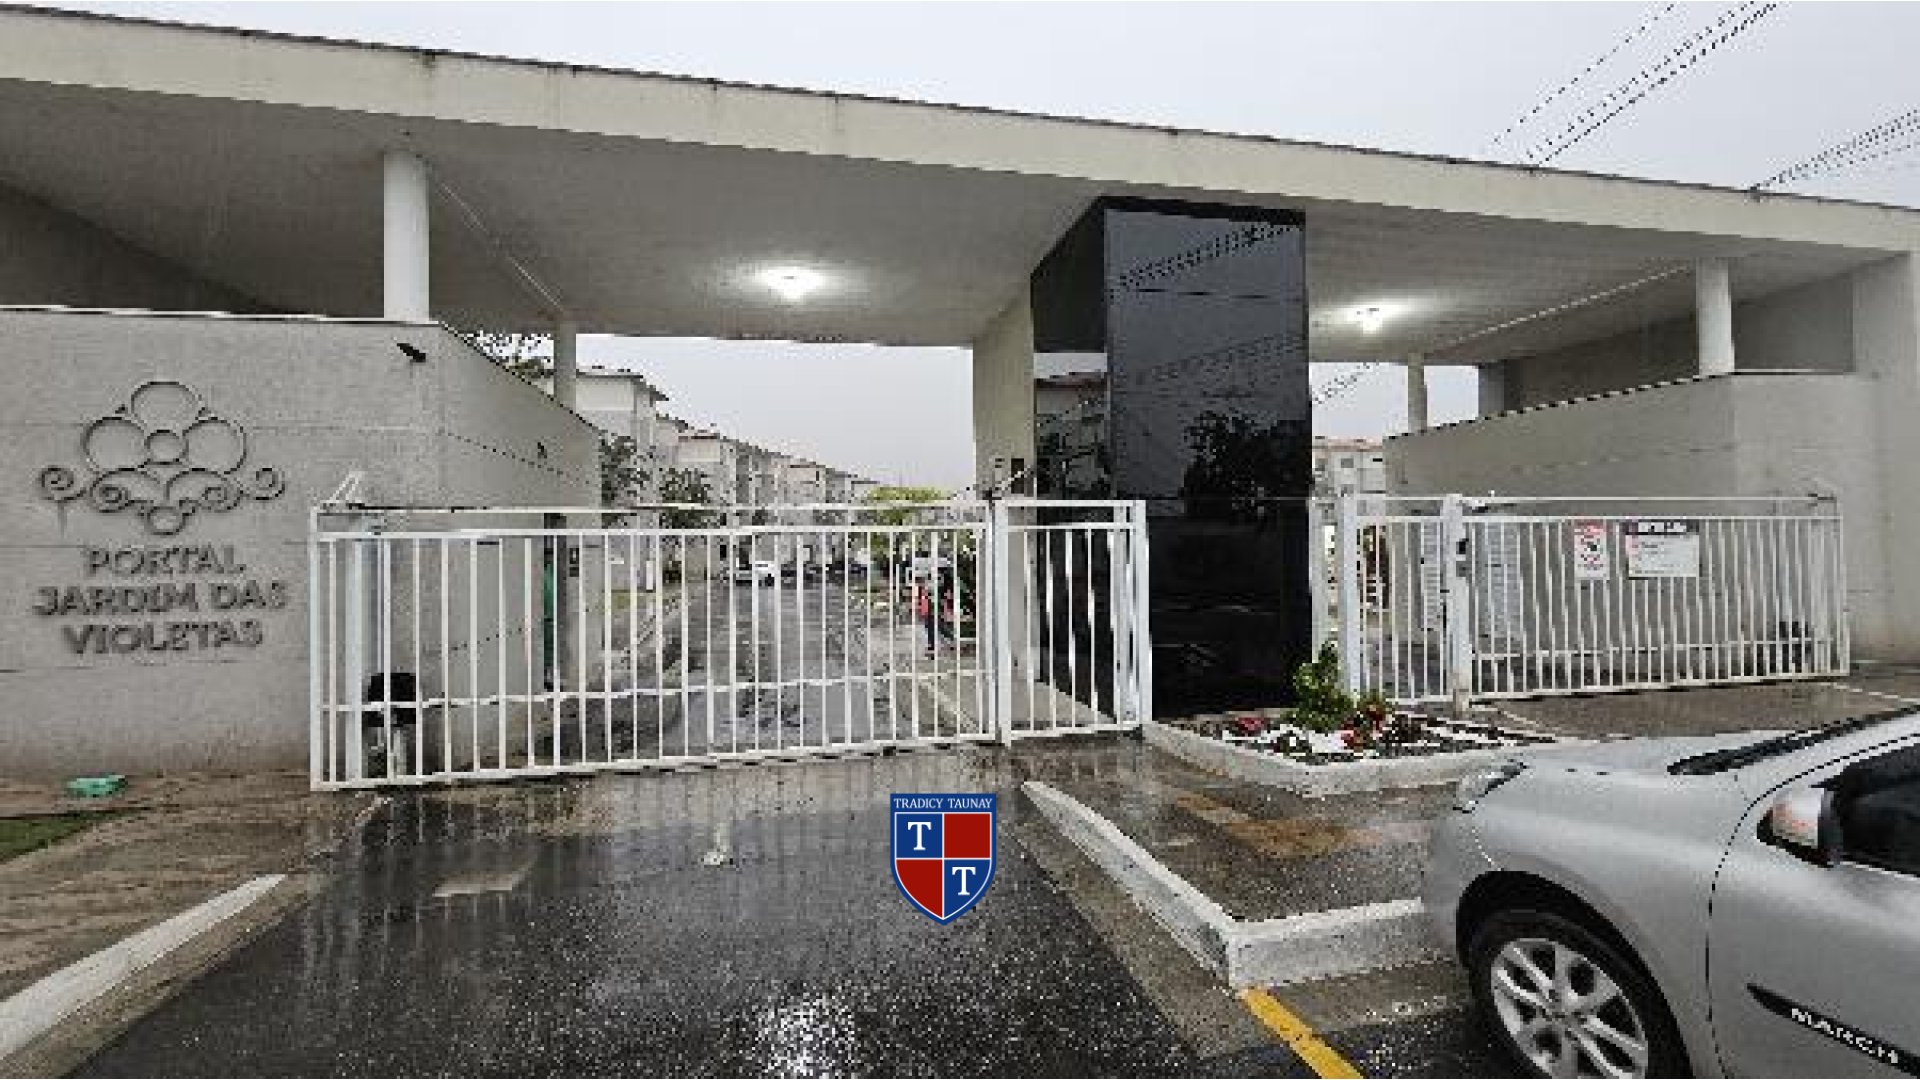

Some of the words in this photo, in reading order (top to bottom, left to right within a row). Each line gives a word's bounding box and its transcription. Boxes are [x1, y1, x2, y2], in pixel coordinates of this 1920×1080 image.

[84, 546, 246, 576] PORTAL
[32, 582, 200, 615] JARDIM
[208, 578, 288, 610] DAS
[61, 620, 264, 655] VIOLETAS
[1791, 1008, 1899, 1065] MARCH
